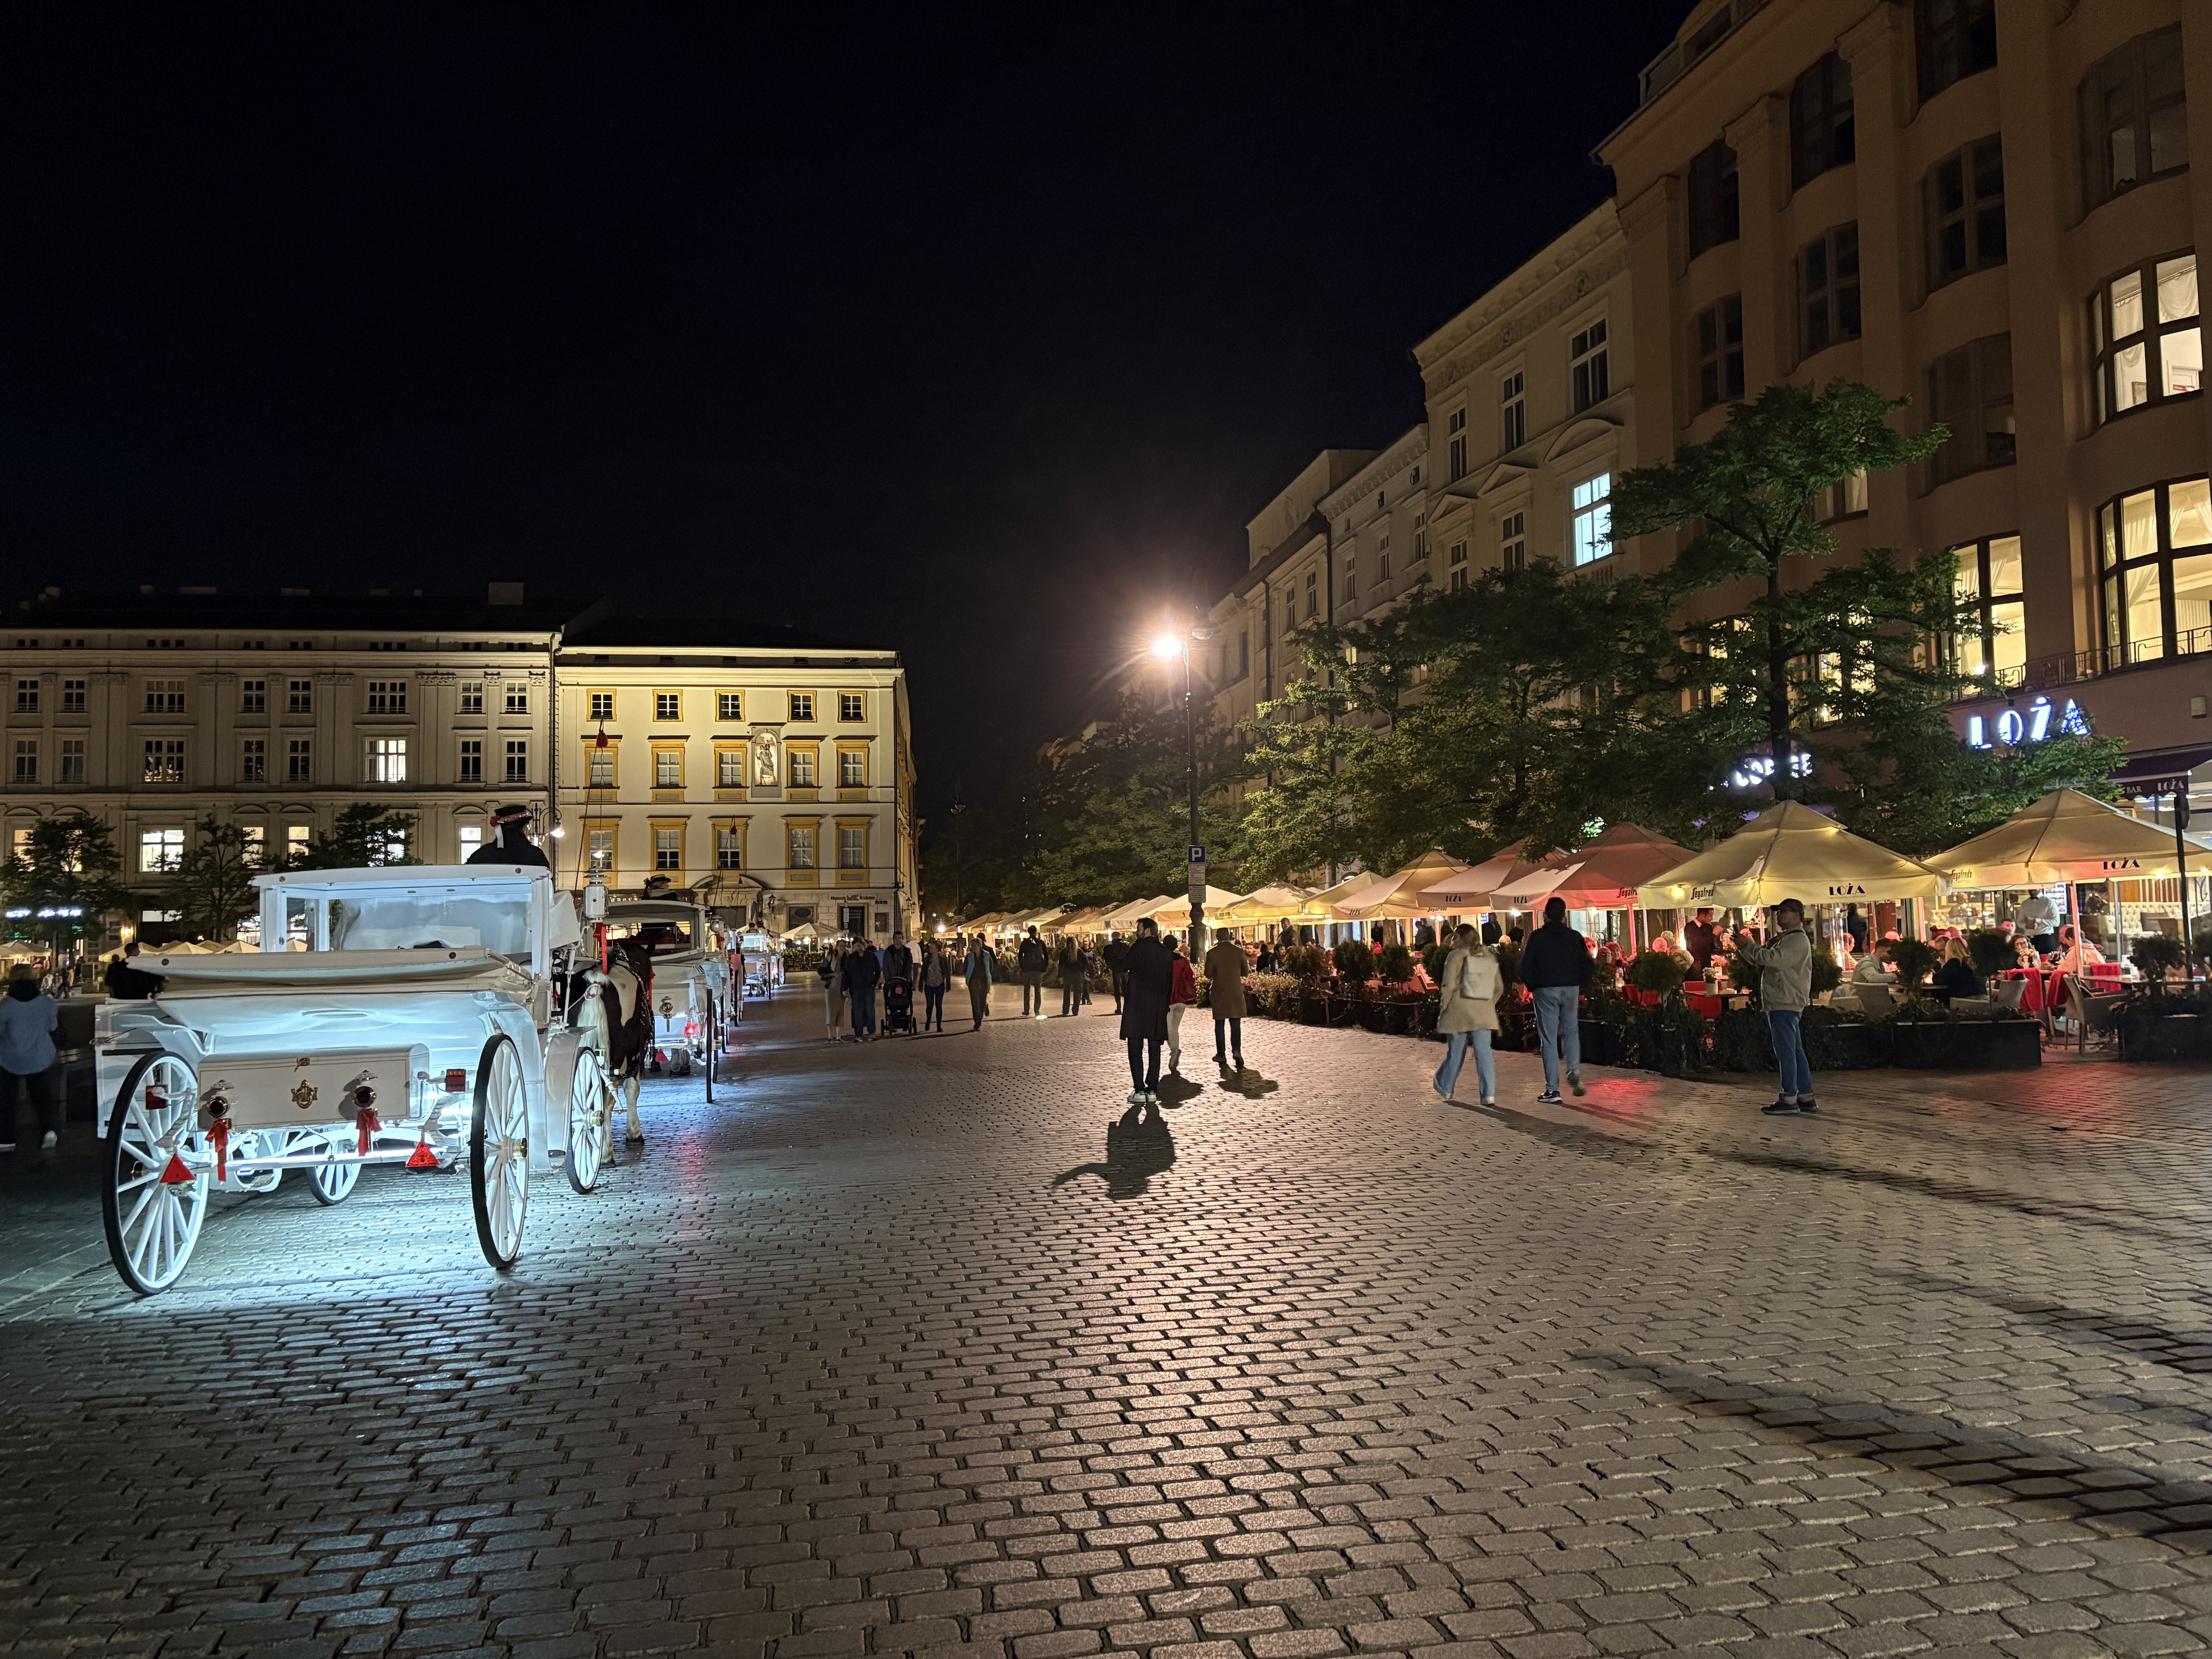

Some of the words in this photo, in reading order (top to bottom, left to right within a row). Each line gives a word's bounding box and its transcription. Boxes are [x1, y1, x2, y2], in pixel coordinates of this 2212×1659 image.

[1970, 696, 2089, 749] LOŻA
[2126, 785, 2142, 794] BAR
[2157, 779, 2184, 791] LOŻA
[1192, 847, 1202, 862] P
[2104, 857, 2140, 870] LOŻA
[1829, 883, 1866, 895] LOŻA
